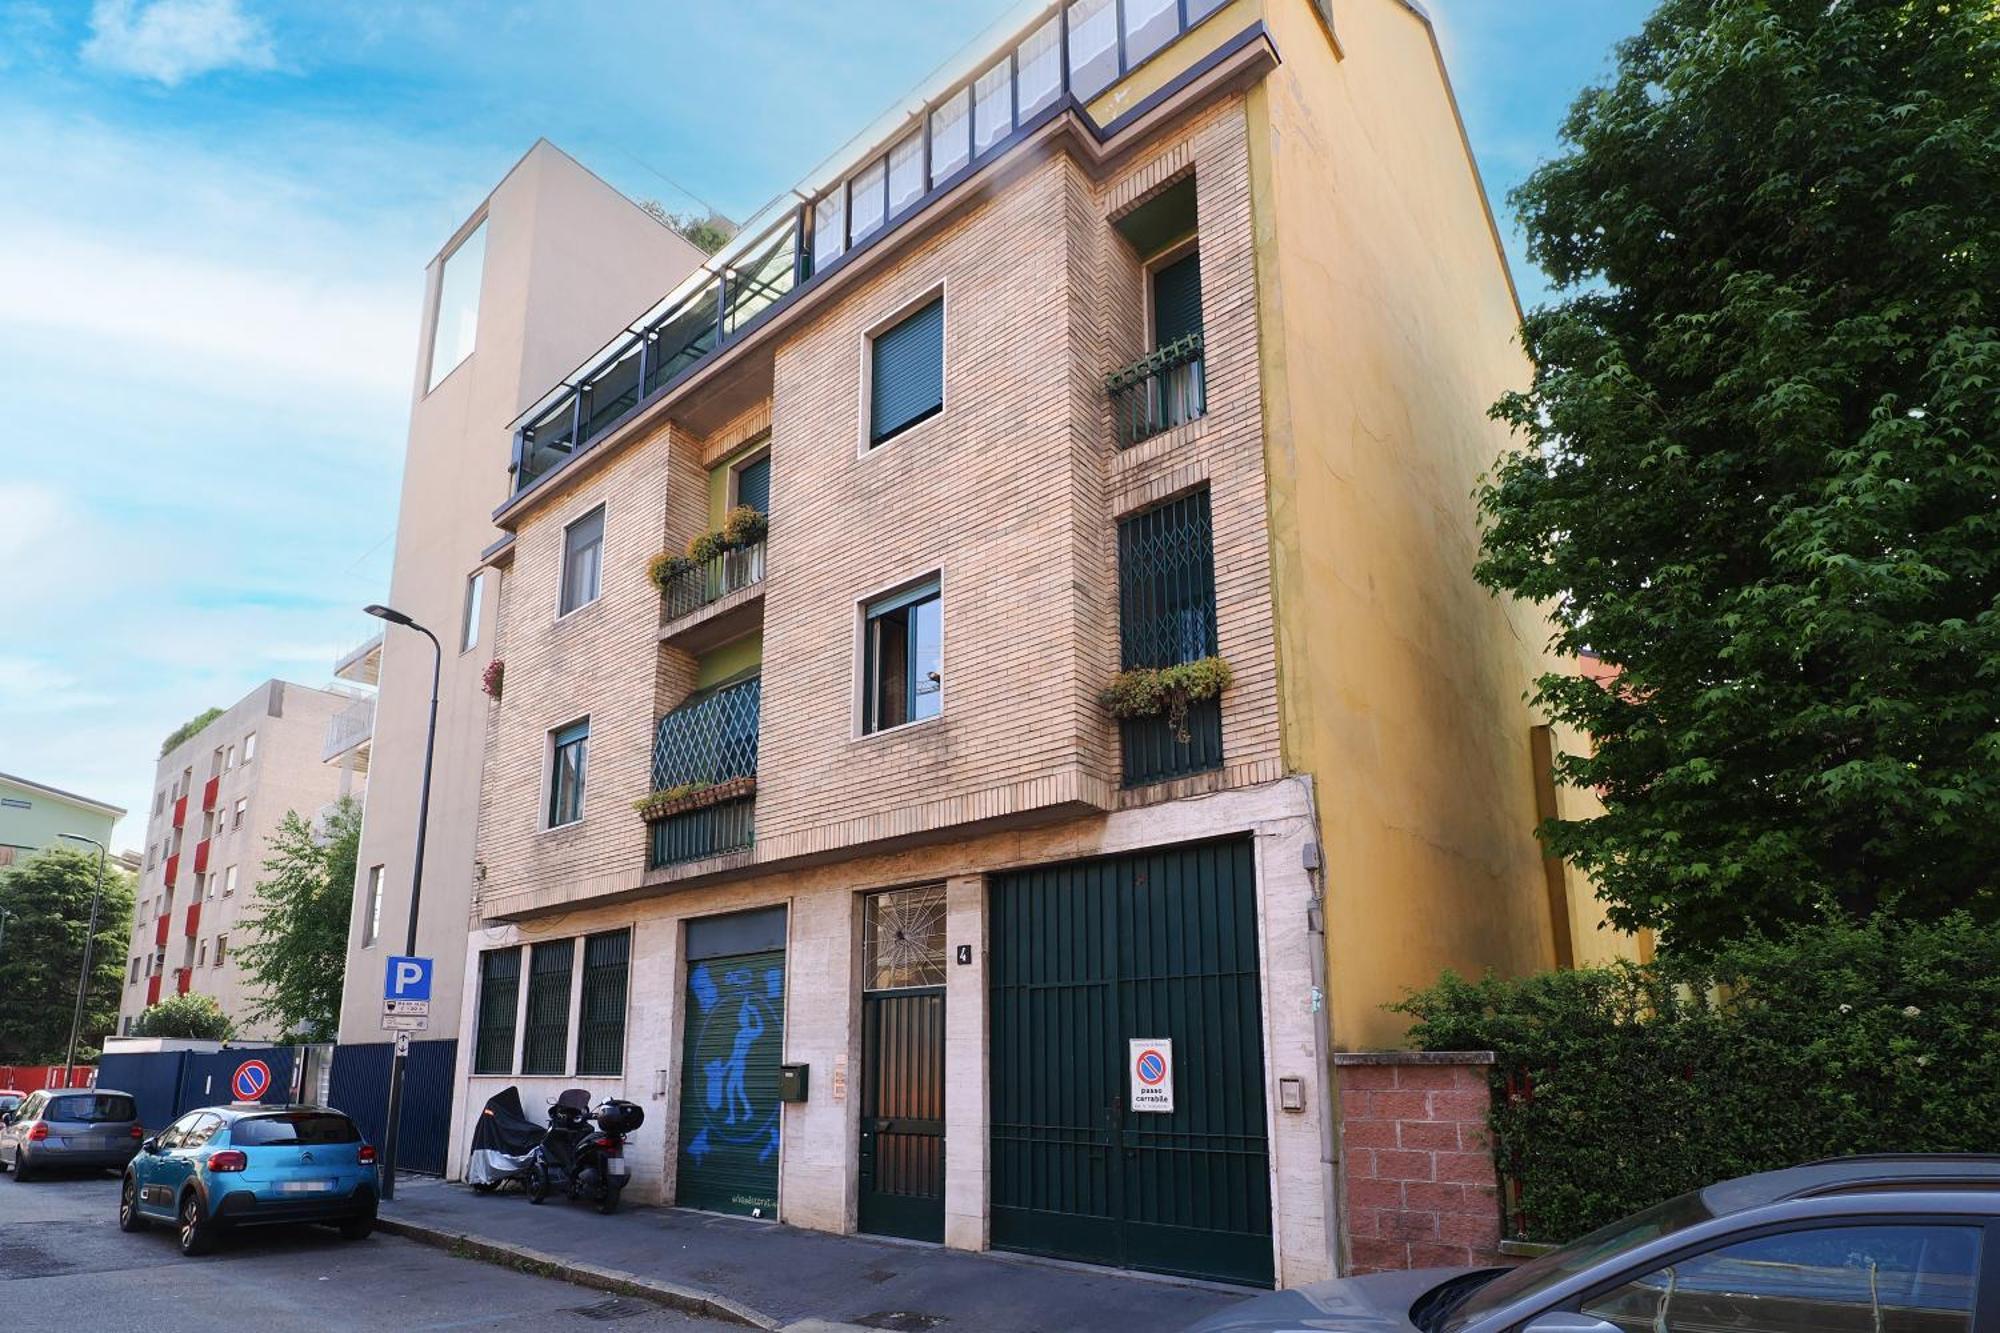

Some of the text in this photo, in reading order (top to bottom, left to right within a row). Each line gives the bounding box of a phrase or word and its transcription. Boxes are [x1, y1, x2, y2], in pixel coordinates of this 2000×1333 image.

[959, 947, 967, 961] 4
[395, 962, 424, 994] P
[1135, 1095, 1169, 1104] carrabile
